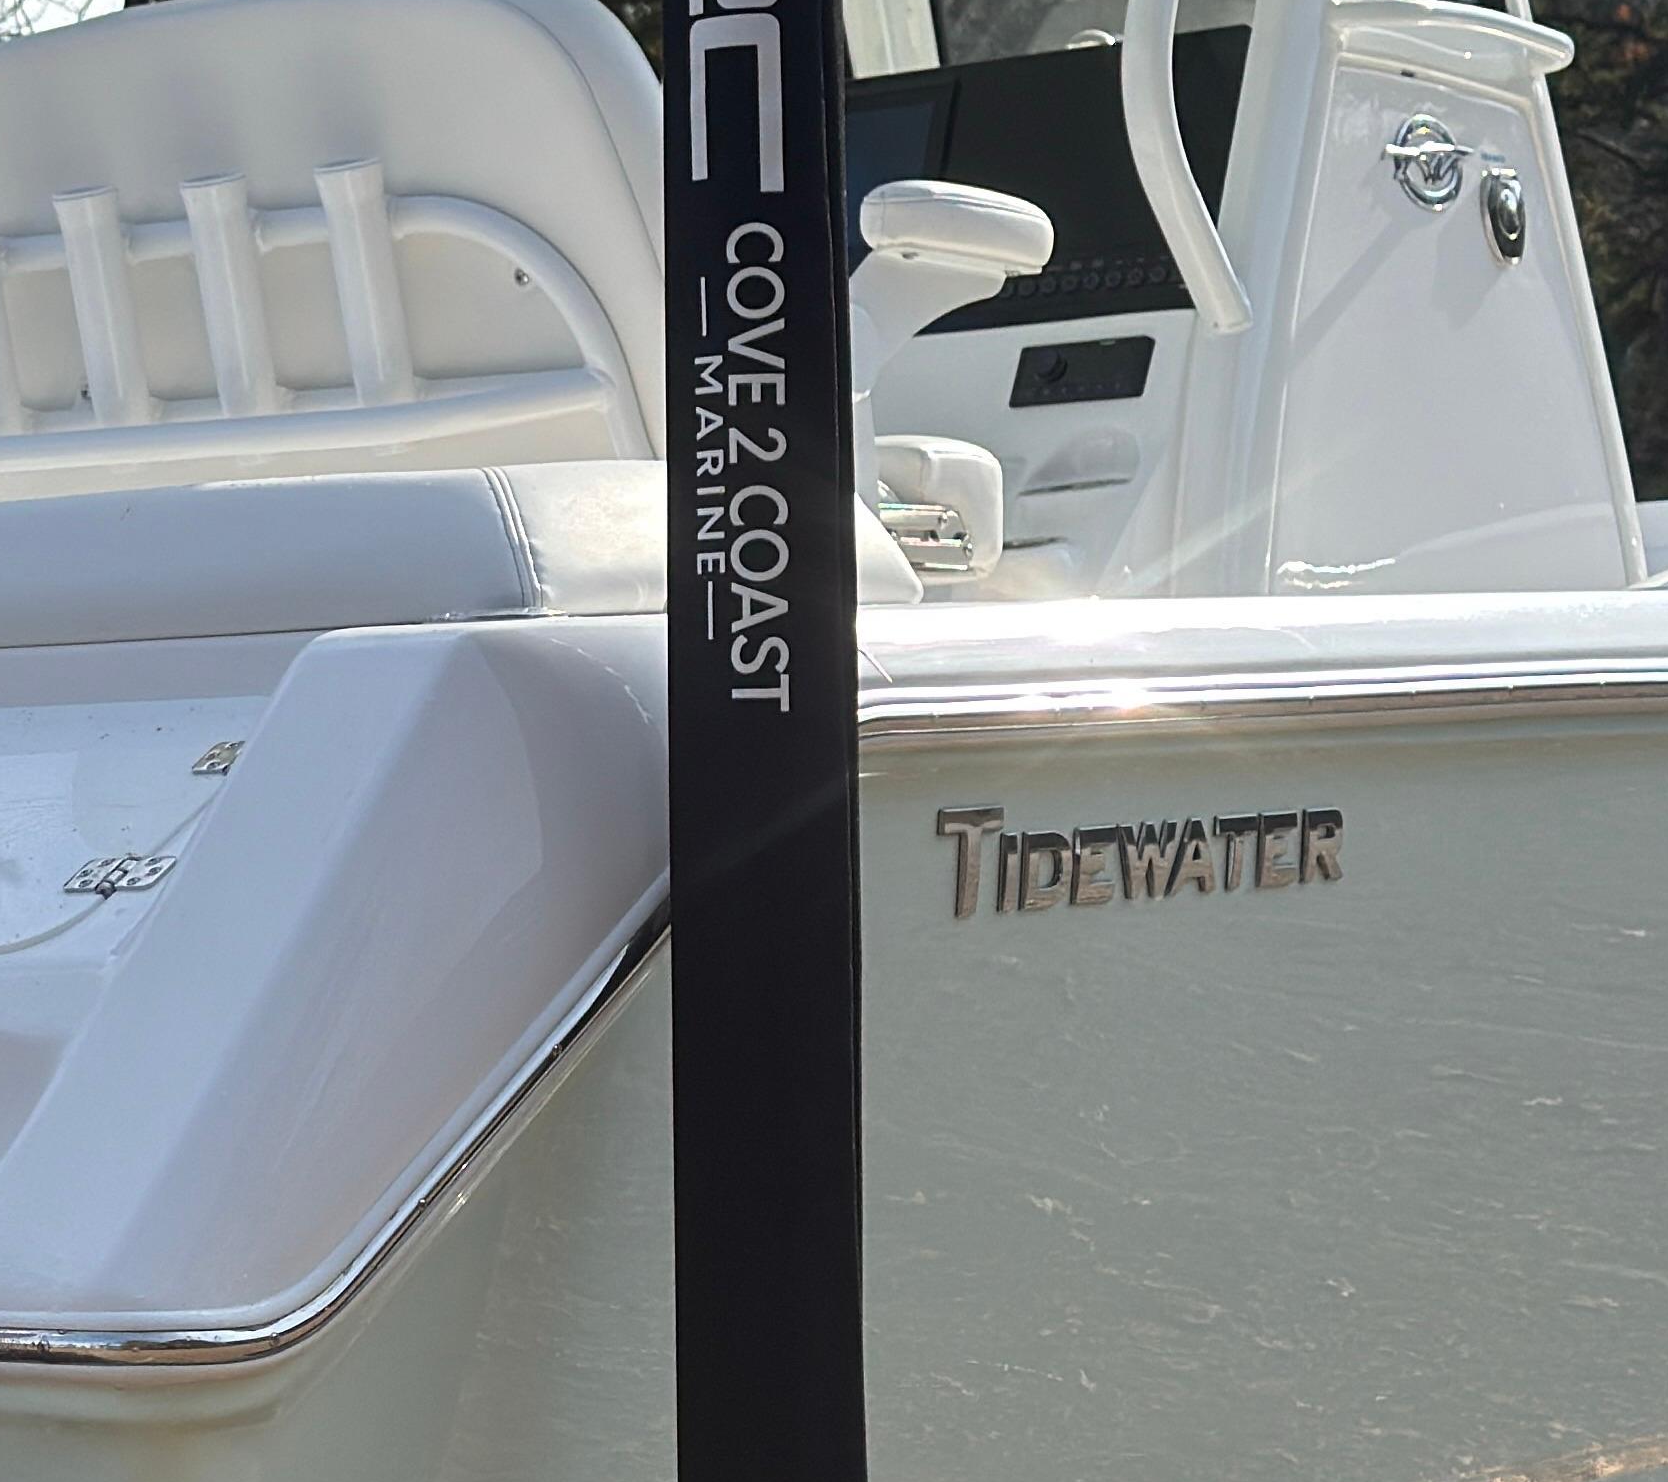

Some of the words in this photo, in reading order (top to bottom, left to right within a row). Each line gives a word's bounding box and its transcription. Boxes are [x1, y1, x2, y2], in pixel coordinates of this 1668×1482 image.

[725, 221, 786, 406] COVE
[694, 355, 726, 576] MARINE
[728, 427, 787, 465] 2
[729, 484, 791, 713] COAST
